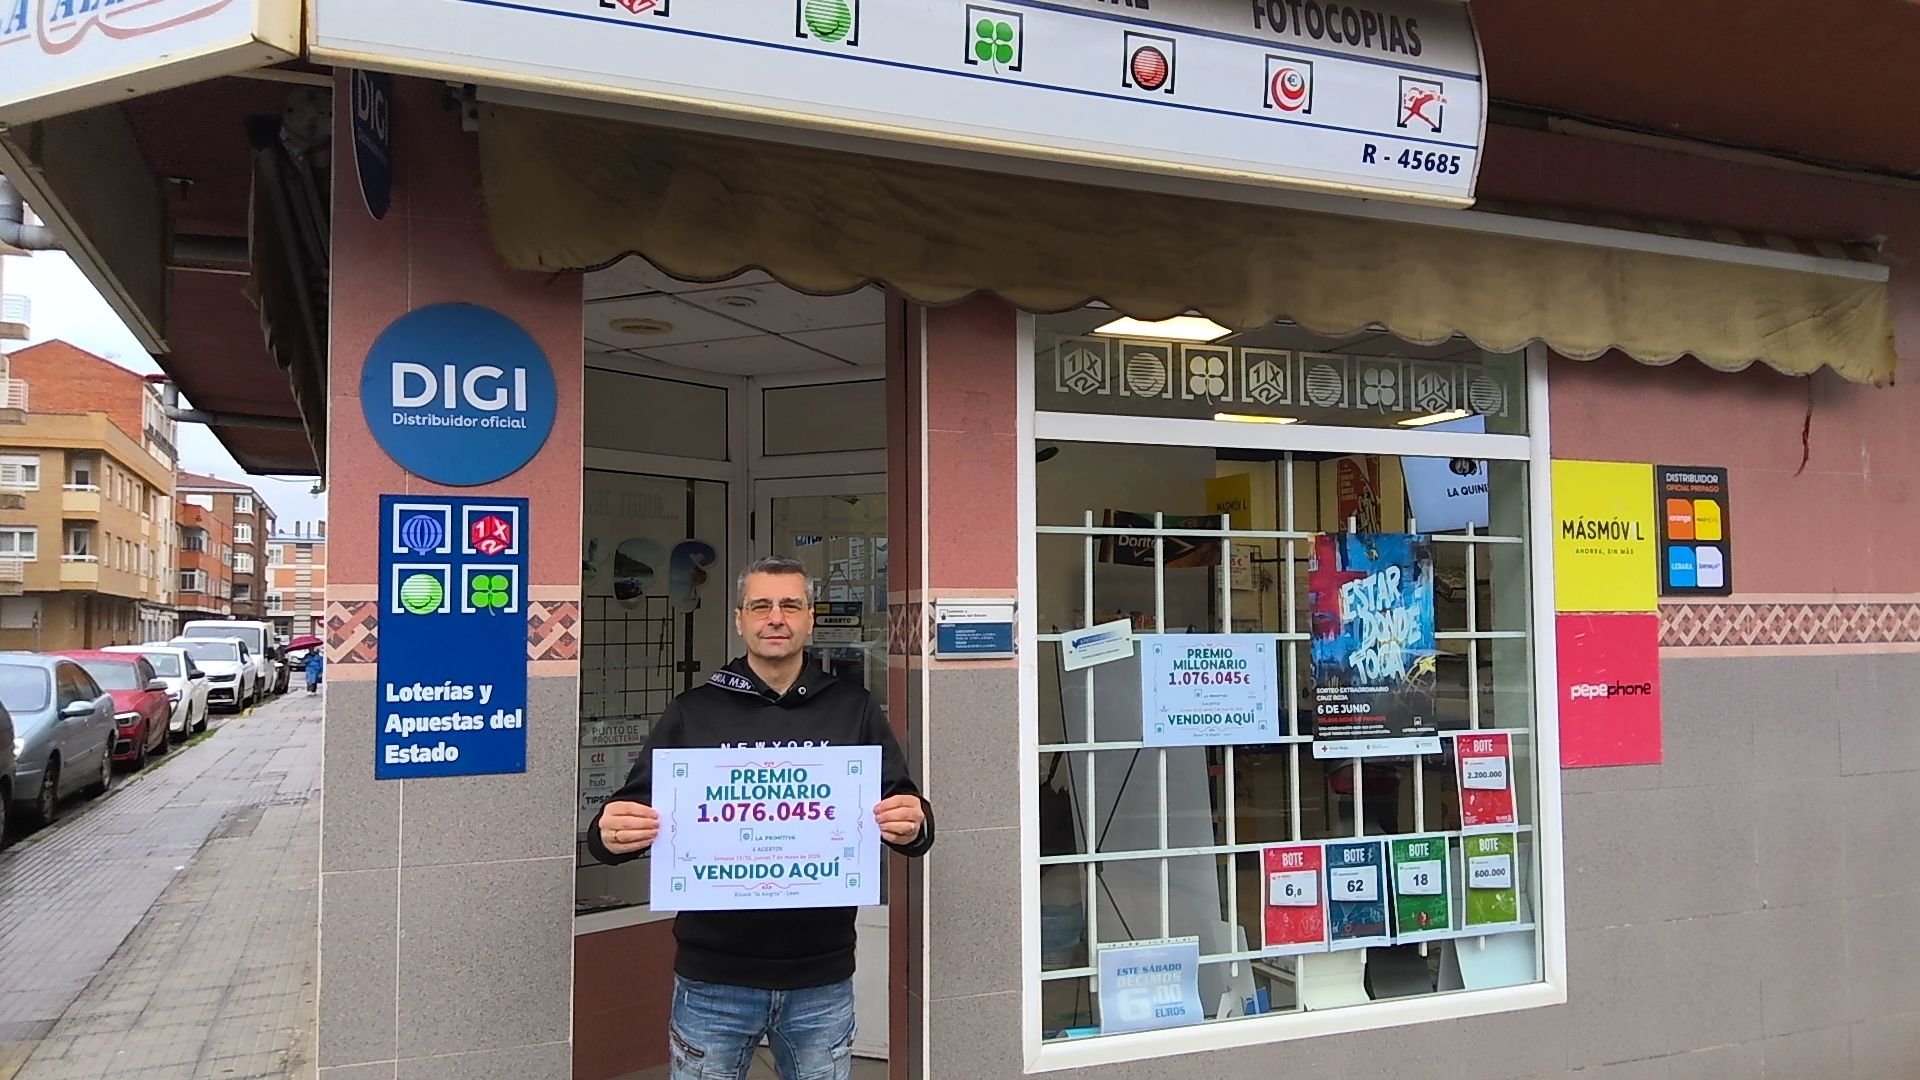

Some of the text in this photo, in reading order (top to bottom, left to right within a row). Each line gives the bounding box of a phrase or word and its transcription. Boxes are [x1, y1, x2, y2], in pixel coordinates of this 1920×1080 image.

[1253, 0, 1422, 57] FOTOCOPIAS
[1362, 143, 1377, 164] R
[1397, 148, 1460, 175] 45685
[392, 362, 527, 412] DIGI
[393, 412, 527, 429] Distribuidor oficial
[1666, 473, 1719, 484] DISTRIBUIDOR
[1447, 483, 1488, 498] LA QUINI
[1666, 483, 1690, 492] OFICIAL
[1341, 565, 1402, 622] ESTAR
[1359, 606, 1422, 651] DONDE
[1187, 648, 1233, 659] PREMIO
[1173, 659, 1247, 670] MILLONARIO
[1349, 641, 1406, 685] TOCA
[386, 681, 493, 704] Loterías y
[1340, 685, 1389, 694] EXTRAORDINARIO
[1570, 680, 1652, 700] pepephone
[1316, 694, 1333, 702] CRUZ
[1317, 703, 1371, 714] 6 DE JUNIO
[385, 708, 522, 738] Apuestas del
[1168, 709, 1255, 725] VENDIDO AQUÍ
[592, 725, 639, 736] PUNTO DE
[385, 742, 459, 764] Estado
[1473, 739, 1493, 753] BOTE
[730, 768, 808, 784] PREMIO
[1467, 771, 1502, 779] 2.200.000
[590, 778, 606, 787] hub
[706, 783, 831, 801] MILLONARIO
[1408, 843, 1430, 857] BOTE
[1479, 838, 1499, 852] BOTE
[1282, 852, 1304, 867] BOTE
[1343, 848, 1365, 863] BOTE
[693, 855, 840, 881] VENDIDO AQUÍ
[1474, 868, 1506, 878] 600.000
[1347, 880, 1364, 893] 62
[1413, 874, 1428, 886] 18
[1117, 963, 1182, 976] ESTE SÁBADO
[1155, 1006, 1186, 1018] EUROS
